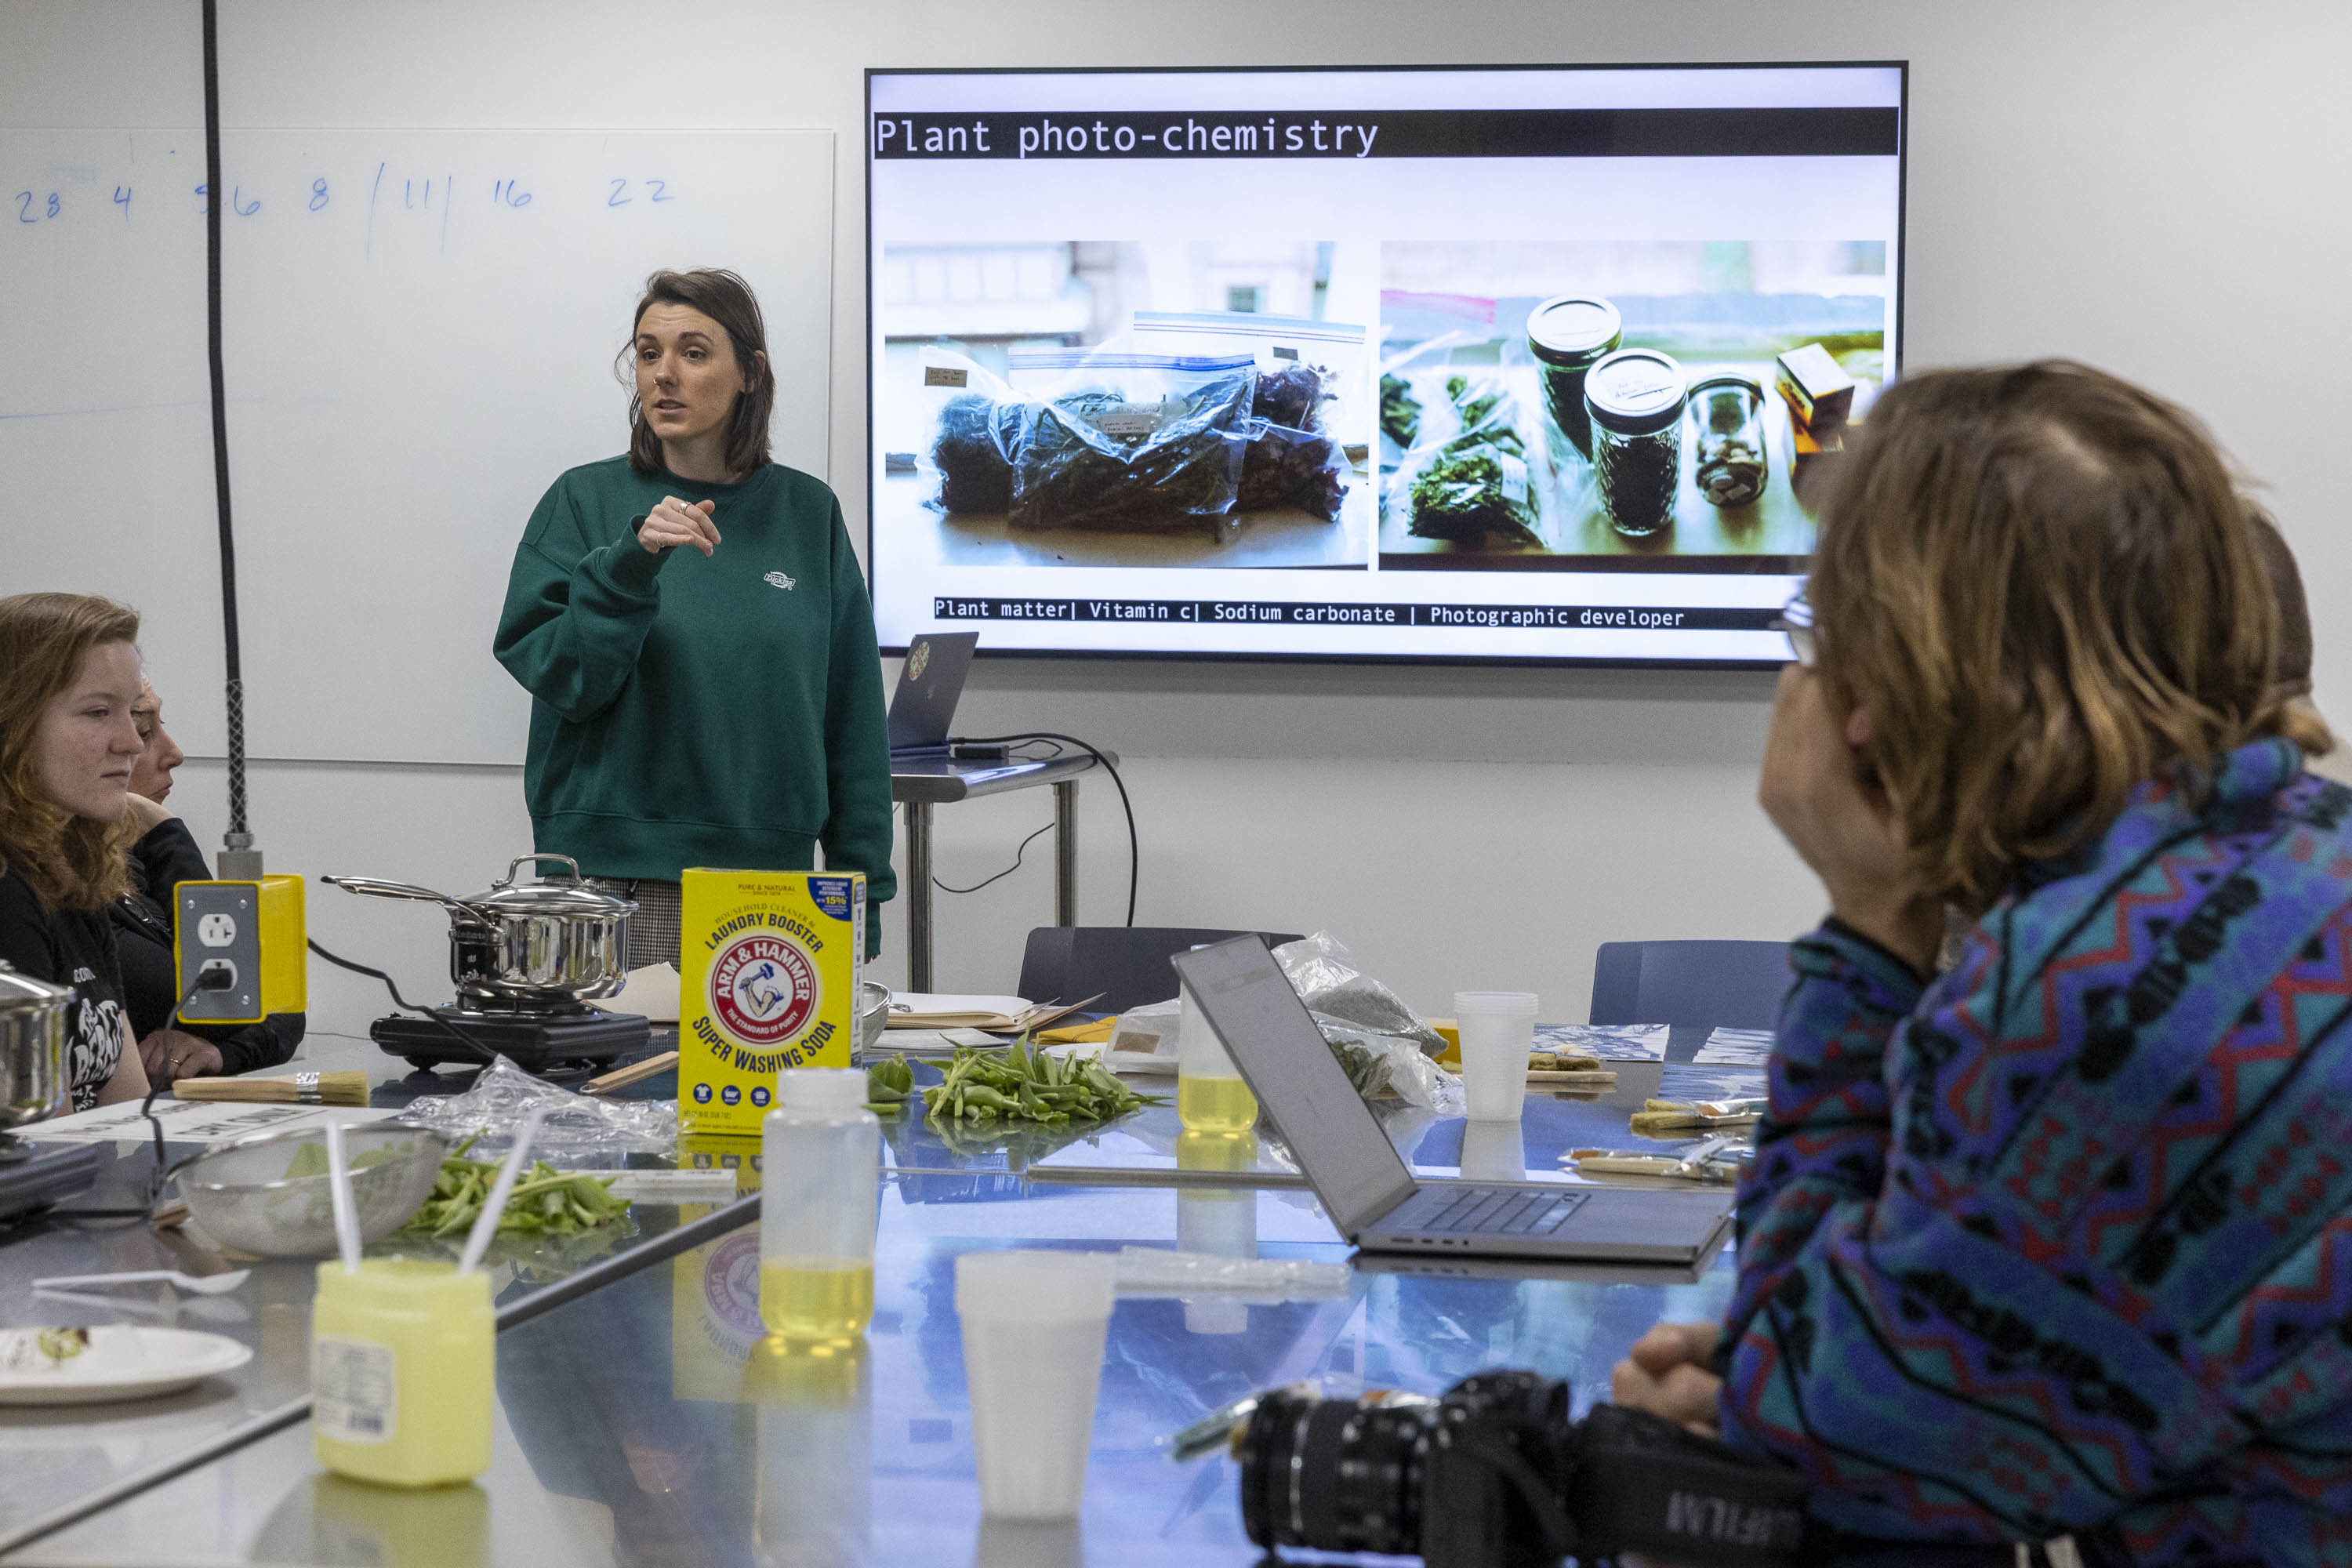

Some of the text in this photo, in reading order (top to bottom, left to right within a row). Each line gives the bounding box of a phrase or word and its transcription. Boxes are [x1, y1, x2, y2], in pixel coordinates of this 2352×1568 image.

[877, 118, 1378, 158] Plant photo-chemistry
[113, 185, 132, 220] 4
[308, 177, 329, 212] 8
[494, 179, 533, 209] 16
[935, 599, 989, 617] Plant
[1089, 601, 1168, 619] Vitamin
[1214, 603, 1282, 622] Sodium
[1293, 604, 1396, 623] carbonate
[1430, 607, 1568, 627] Photographic
[1580, 608, 1685, 629] developer
[705, 913, 824, 953] LAUNDRY BOOSTER
[715, 903, 768, 924] HOUSEHOLD
[770, 904, 808, 921] CLEANER
[717, 942, 810, 1001] ARM & HAMMER
[727, 1008, 739, 1022] THE
[737, 1018, 770, 1034] STANDARD
[770, 1024, 779, 1033] OF
[692, 1016, 837, 1073] SUPER WASHING SODA
